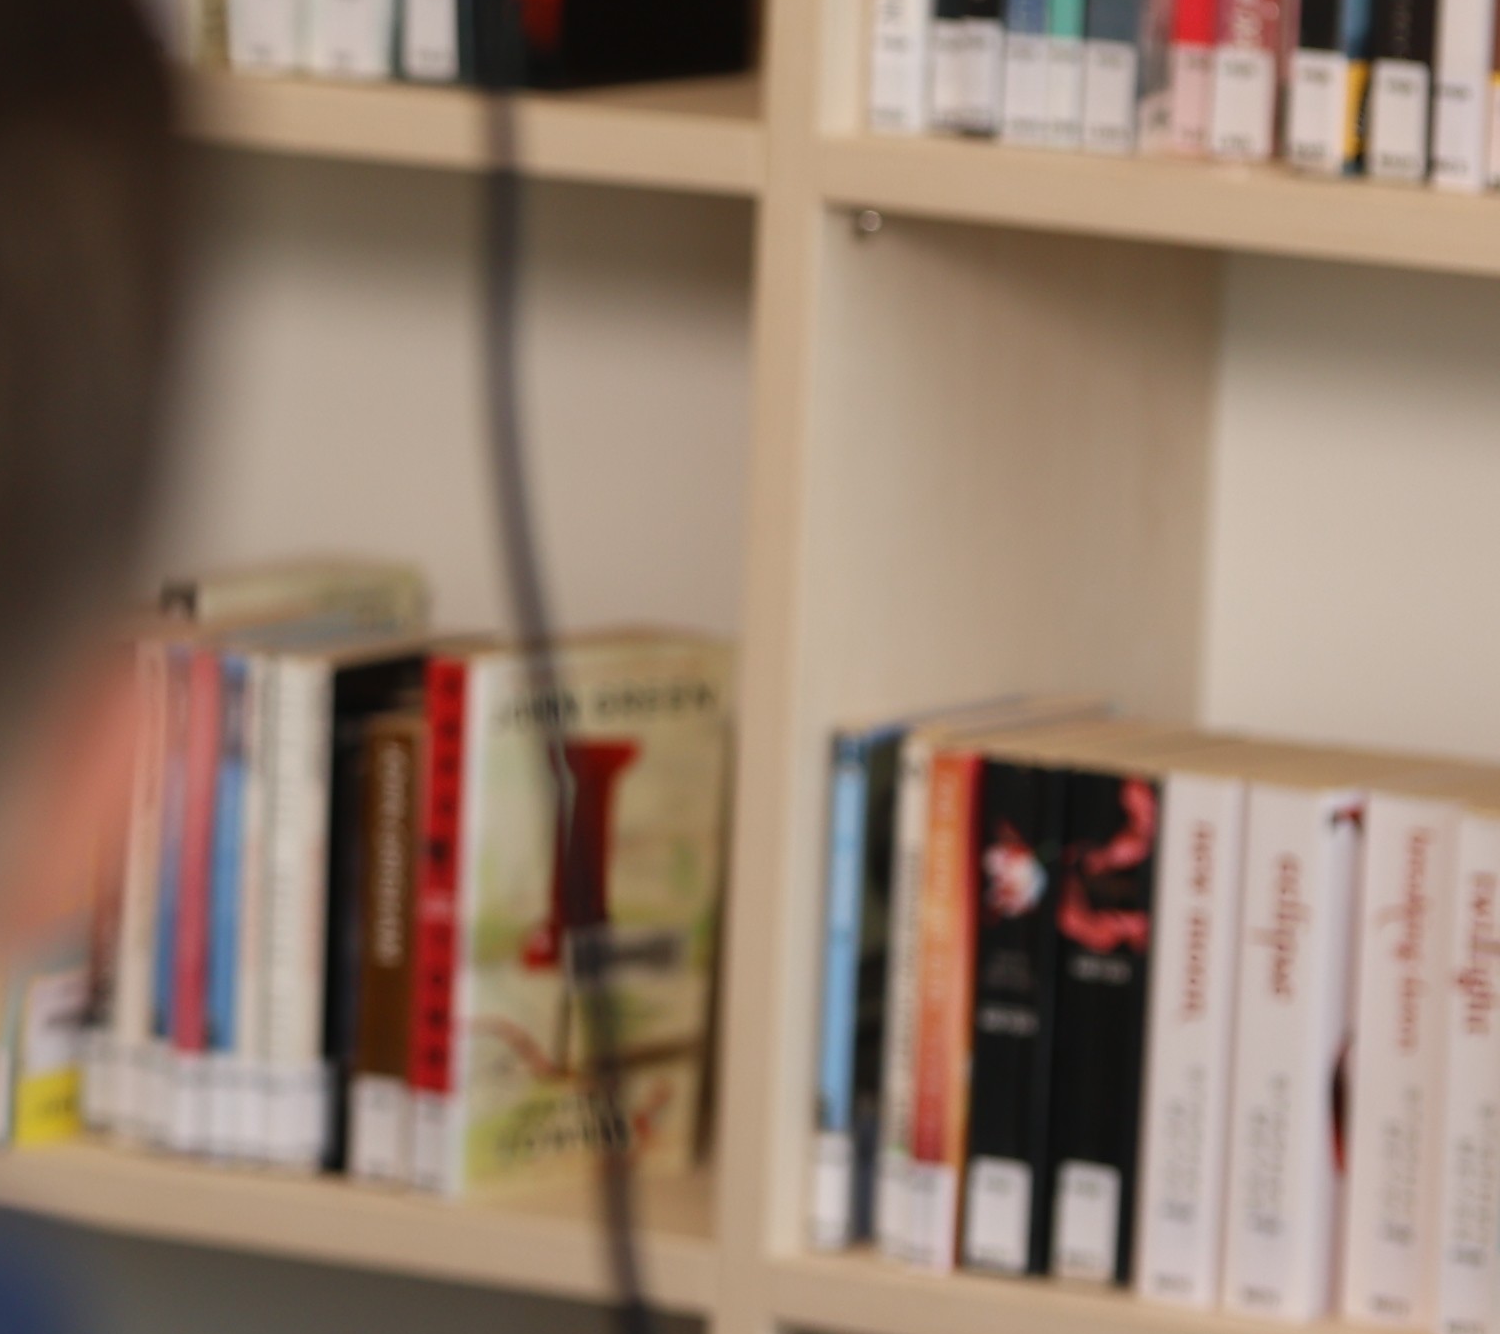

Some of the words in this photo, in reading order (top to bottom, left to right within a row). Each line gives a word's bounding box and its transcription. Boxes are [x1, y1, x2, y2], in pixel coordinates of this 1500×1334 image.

[1186, 821, 1218, 898] new
[1180, 907, 1217, 1022] moon
[1246, 853, 1310, 1005] eclipse
[1448, 871, 1500, 1041] twilight
